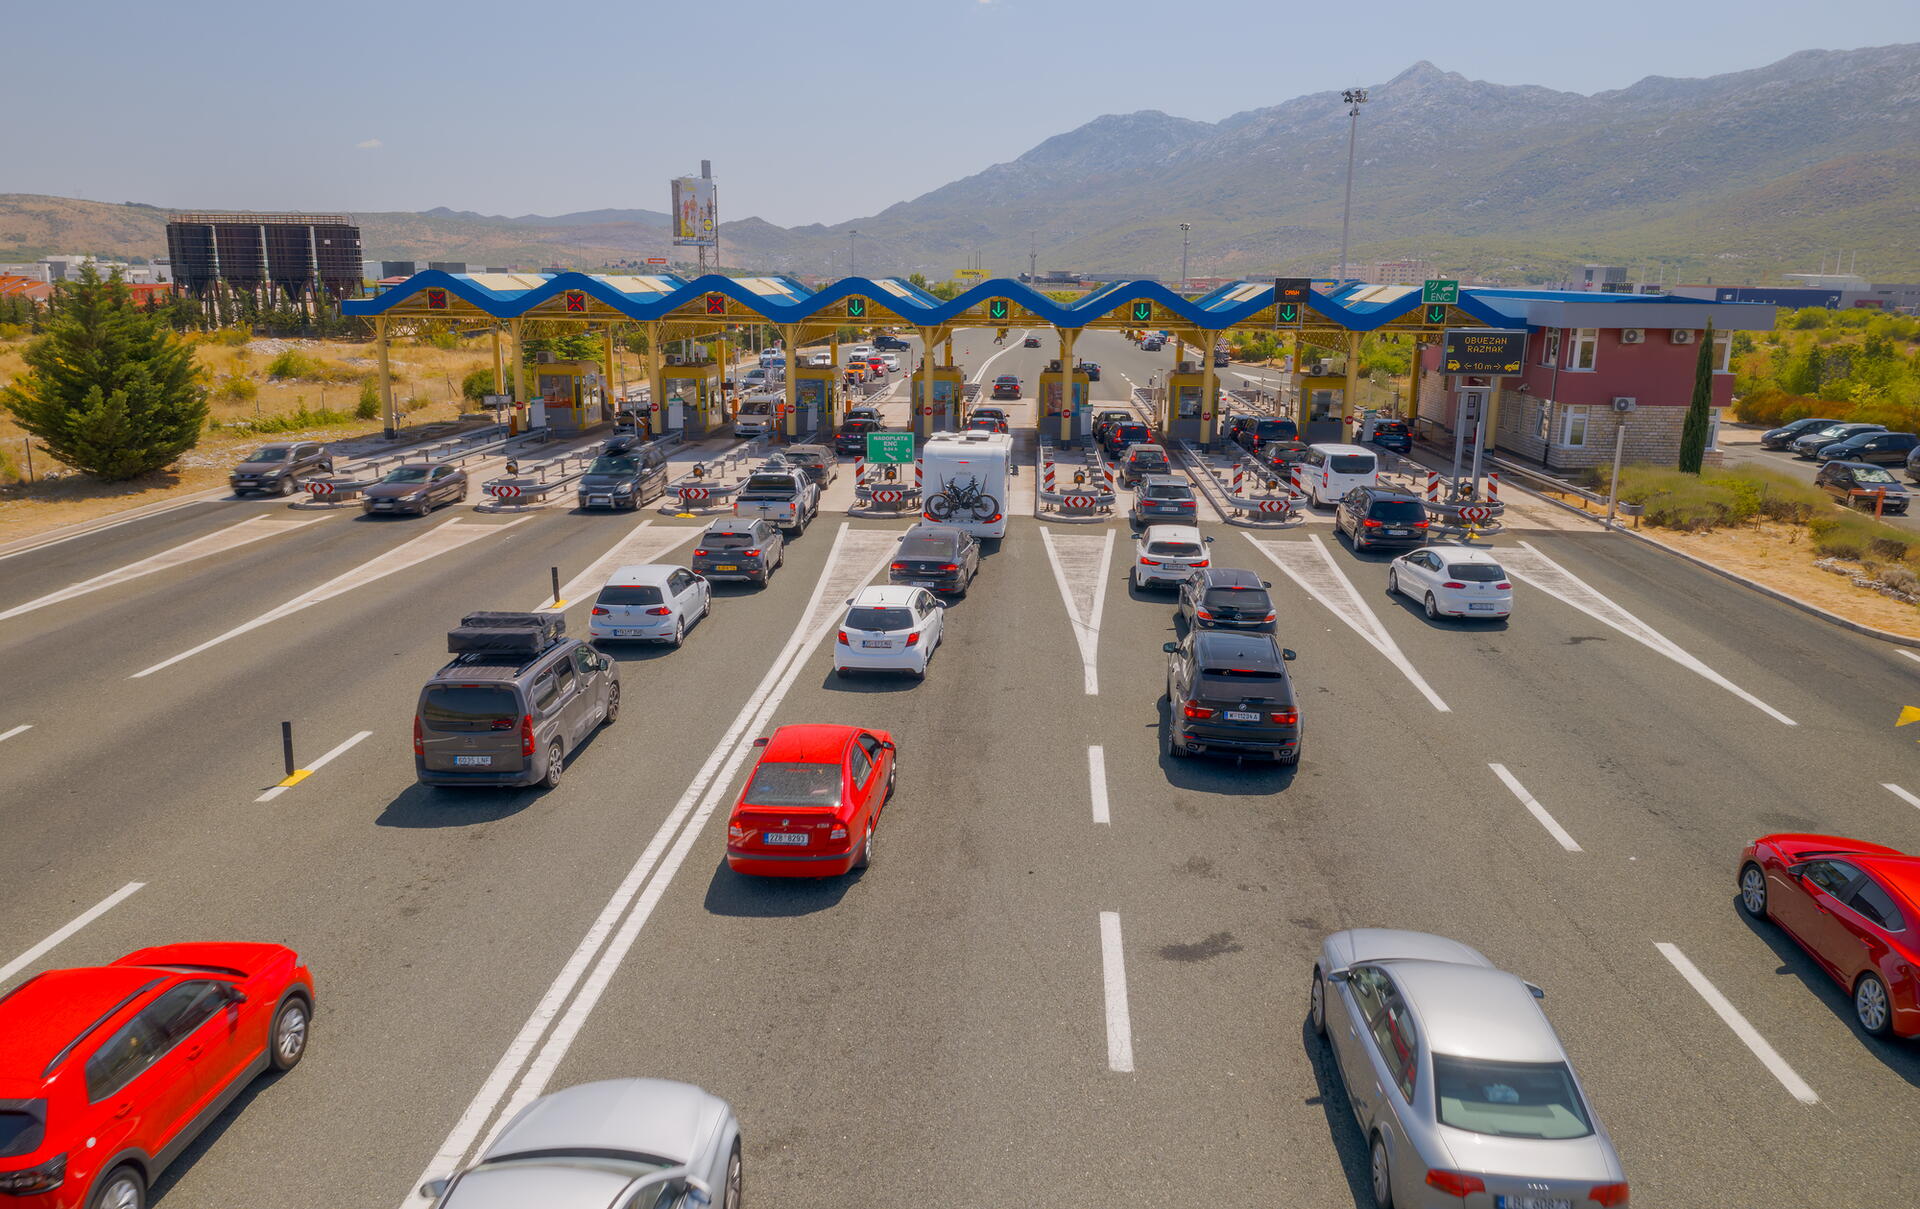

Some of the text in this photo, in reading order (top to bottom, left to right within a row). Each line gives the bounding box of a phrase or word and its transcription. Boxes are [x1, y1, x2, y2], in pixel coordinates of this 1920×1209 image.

[1430, 292, 1451, 302] ENC
[1464, 336, 1507, 345] OBVEZAN
[1467, 345, 1504, 353] RAZMAK
